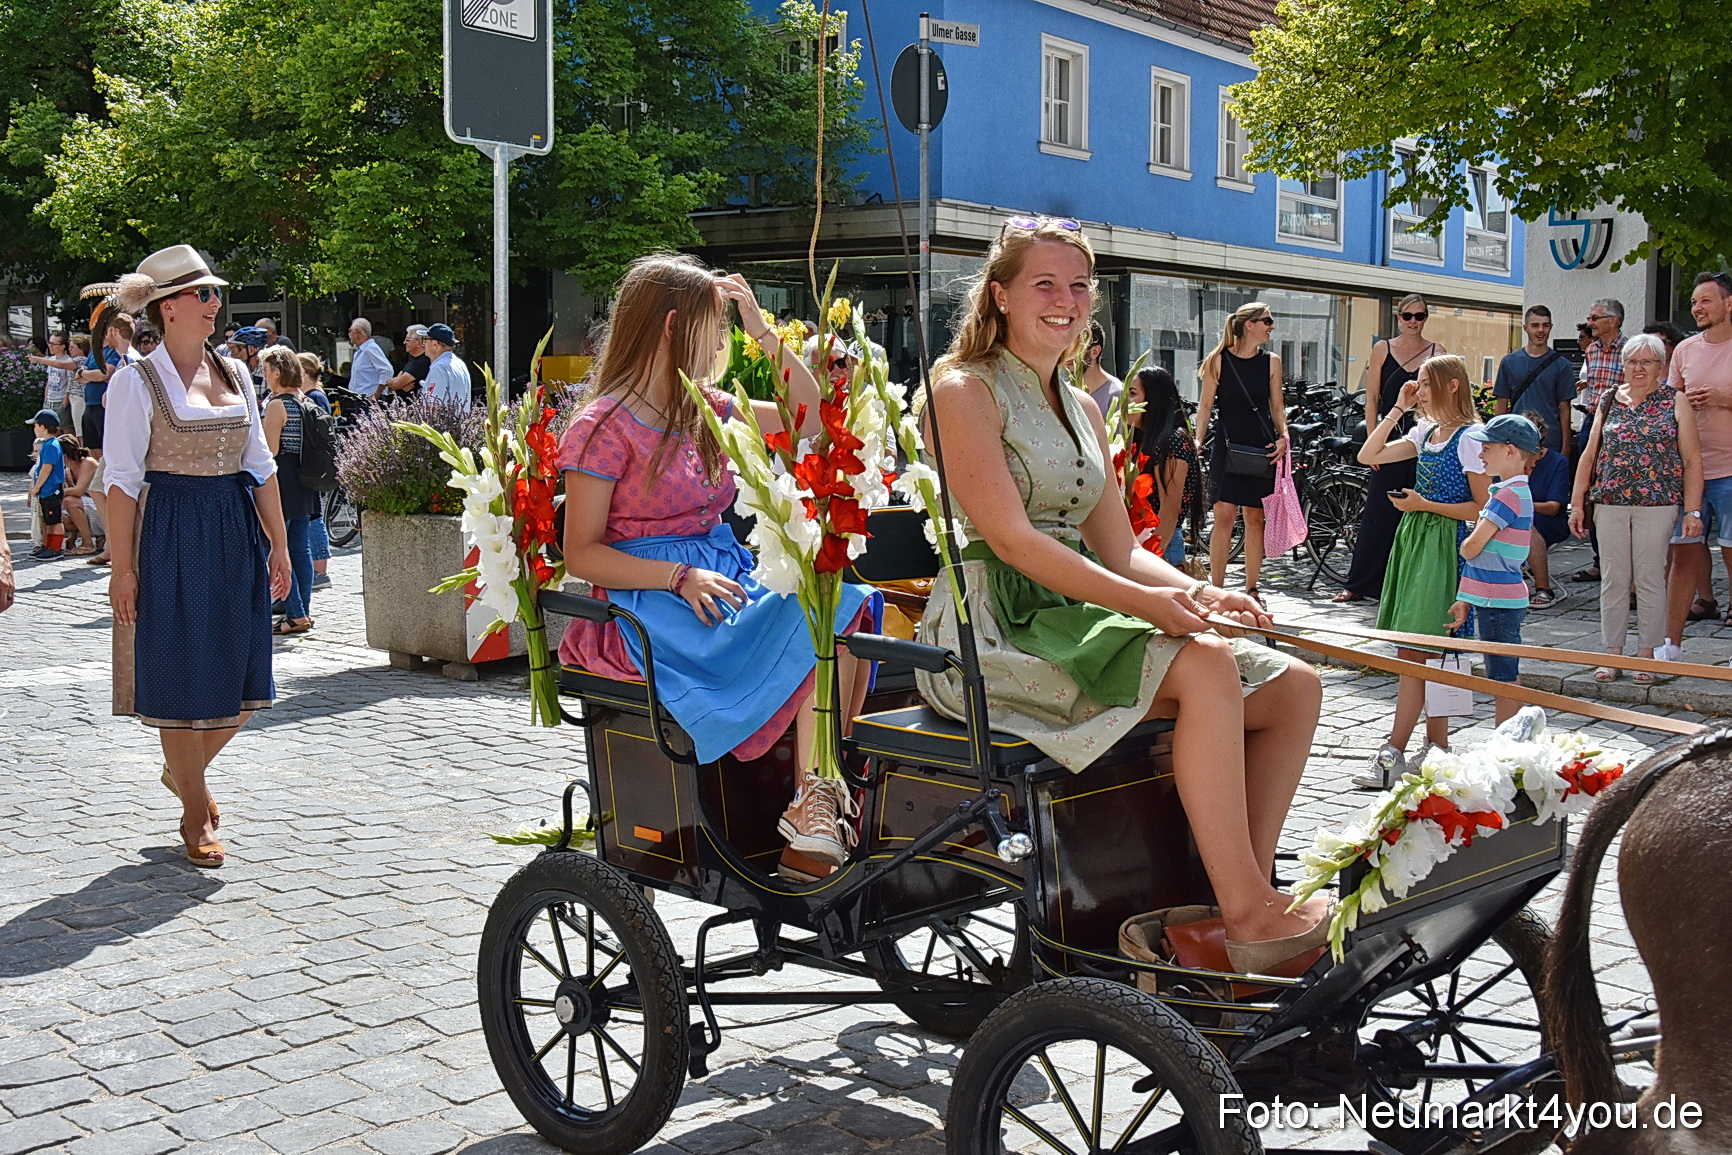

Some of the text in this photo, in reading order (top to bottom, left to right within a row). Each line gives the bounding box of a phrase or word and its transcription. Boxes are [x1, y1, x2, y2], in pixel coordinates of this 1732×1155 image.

[481, 7, 518, 29] ZONE
[932, 23, 976, 42] Ulmer Gasse
[1281, 213, 1306, 227] ANTON
